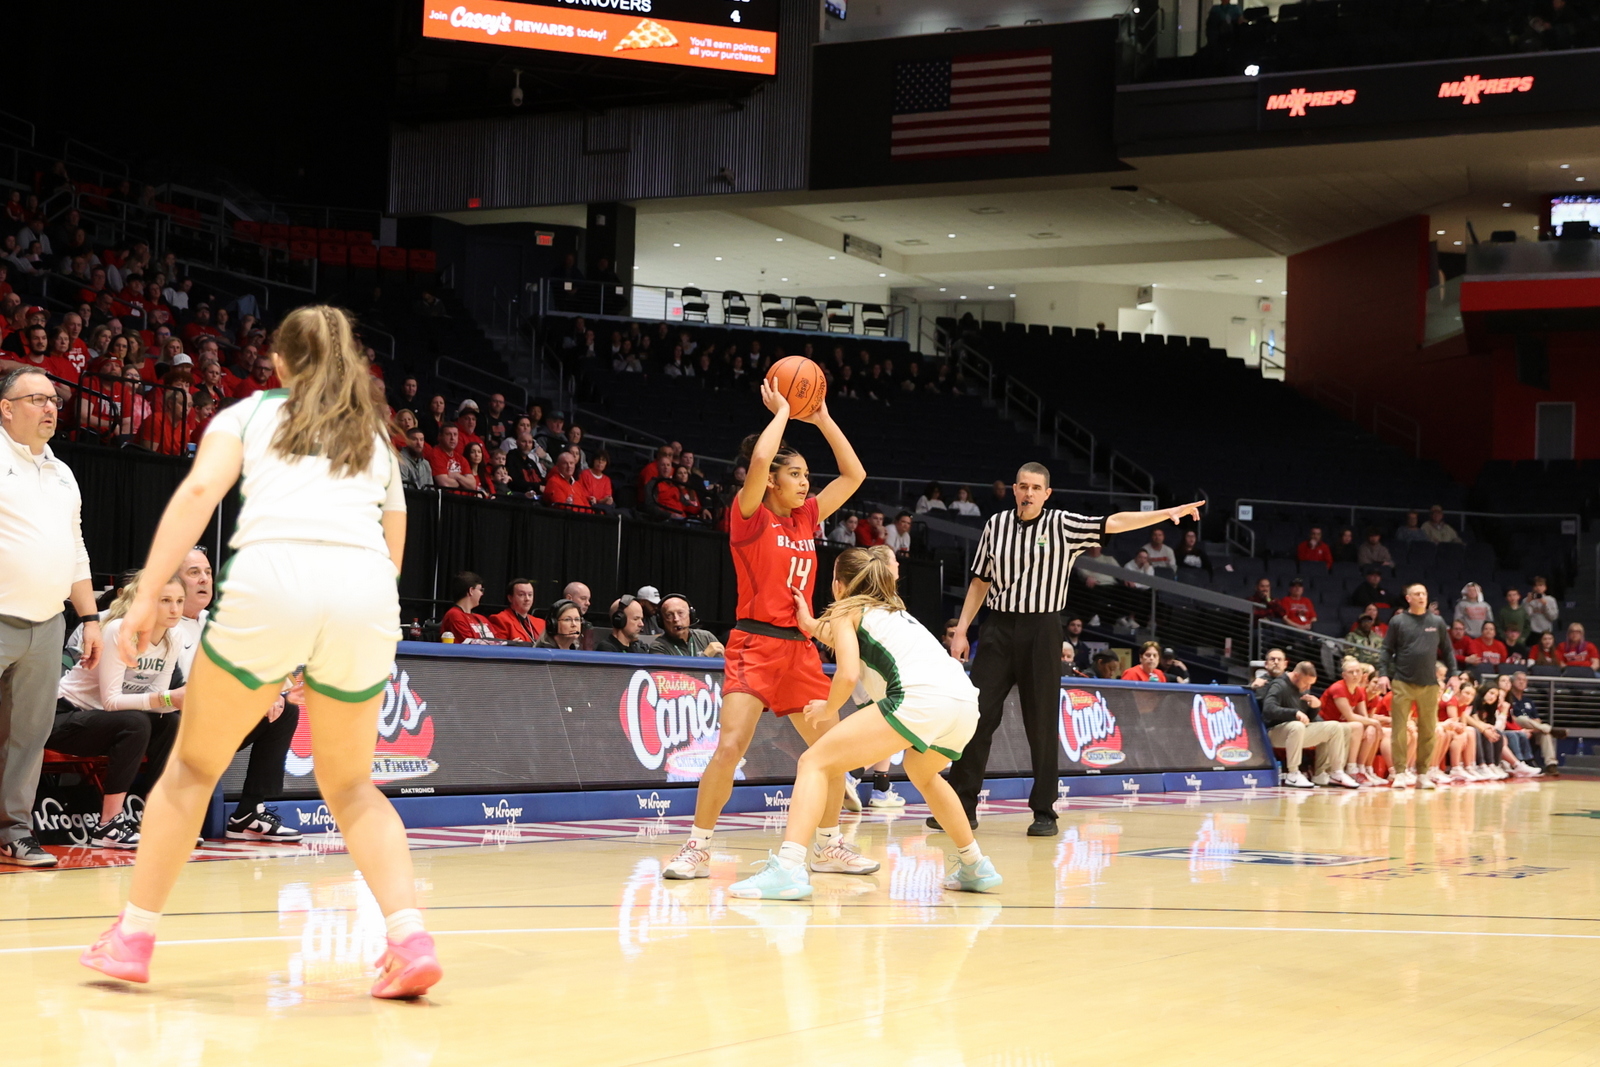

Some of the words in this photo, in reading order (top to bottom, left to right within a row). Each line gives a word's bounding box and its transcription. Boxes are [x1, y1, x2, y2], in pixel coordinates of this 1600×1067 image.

[557, 0, 652, 12] NOVERS
[730, 9, 741, 23] 4
[429, 10, 448, 21] Join
[450, 6, 511, 36] Casey's
[514, 20, 574, 37] REWARDS
[576, 28, 607, 42] today!
[689, 37, 712, 49] You'll
[713, 41, 731, 50] earn
[733, 43, 757, 53] points
[759, 46, 771, 54] on
[689, 47, 699, 56] all
[701, 49, 718, 59] your
[720, 51, 764, 63] purchases.
[1437, 74, 1534, 104] MAXPREPS
[1266, 88, 1356, 117] MAXPREPS
[786, 555, 812, 591] 14
[656, 675, 696, 695] Raising
[495, 798, 523, 824] Kroger
[648, 791, 671, 817] Kroger
[773, 790, 791, 812] Kroge
[34, 797, 101, 845] Kroger
[312, 804, 336, 832] Krog
